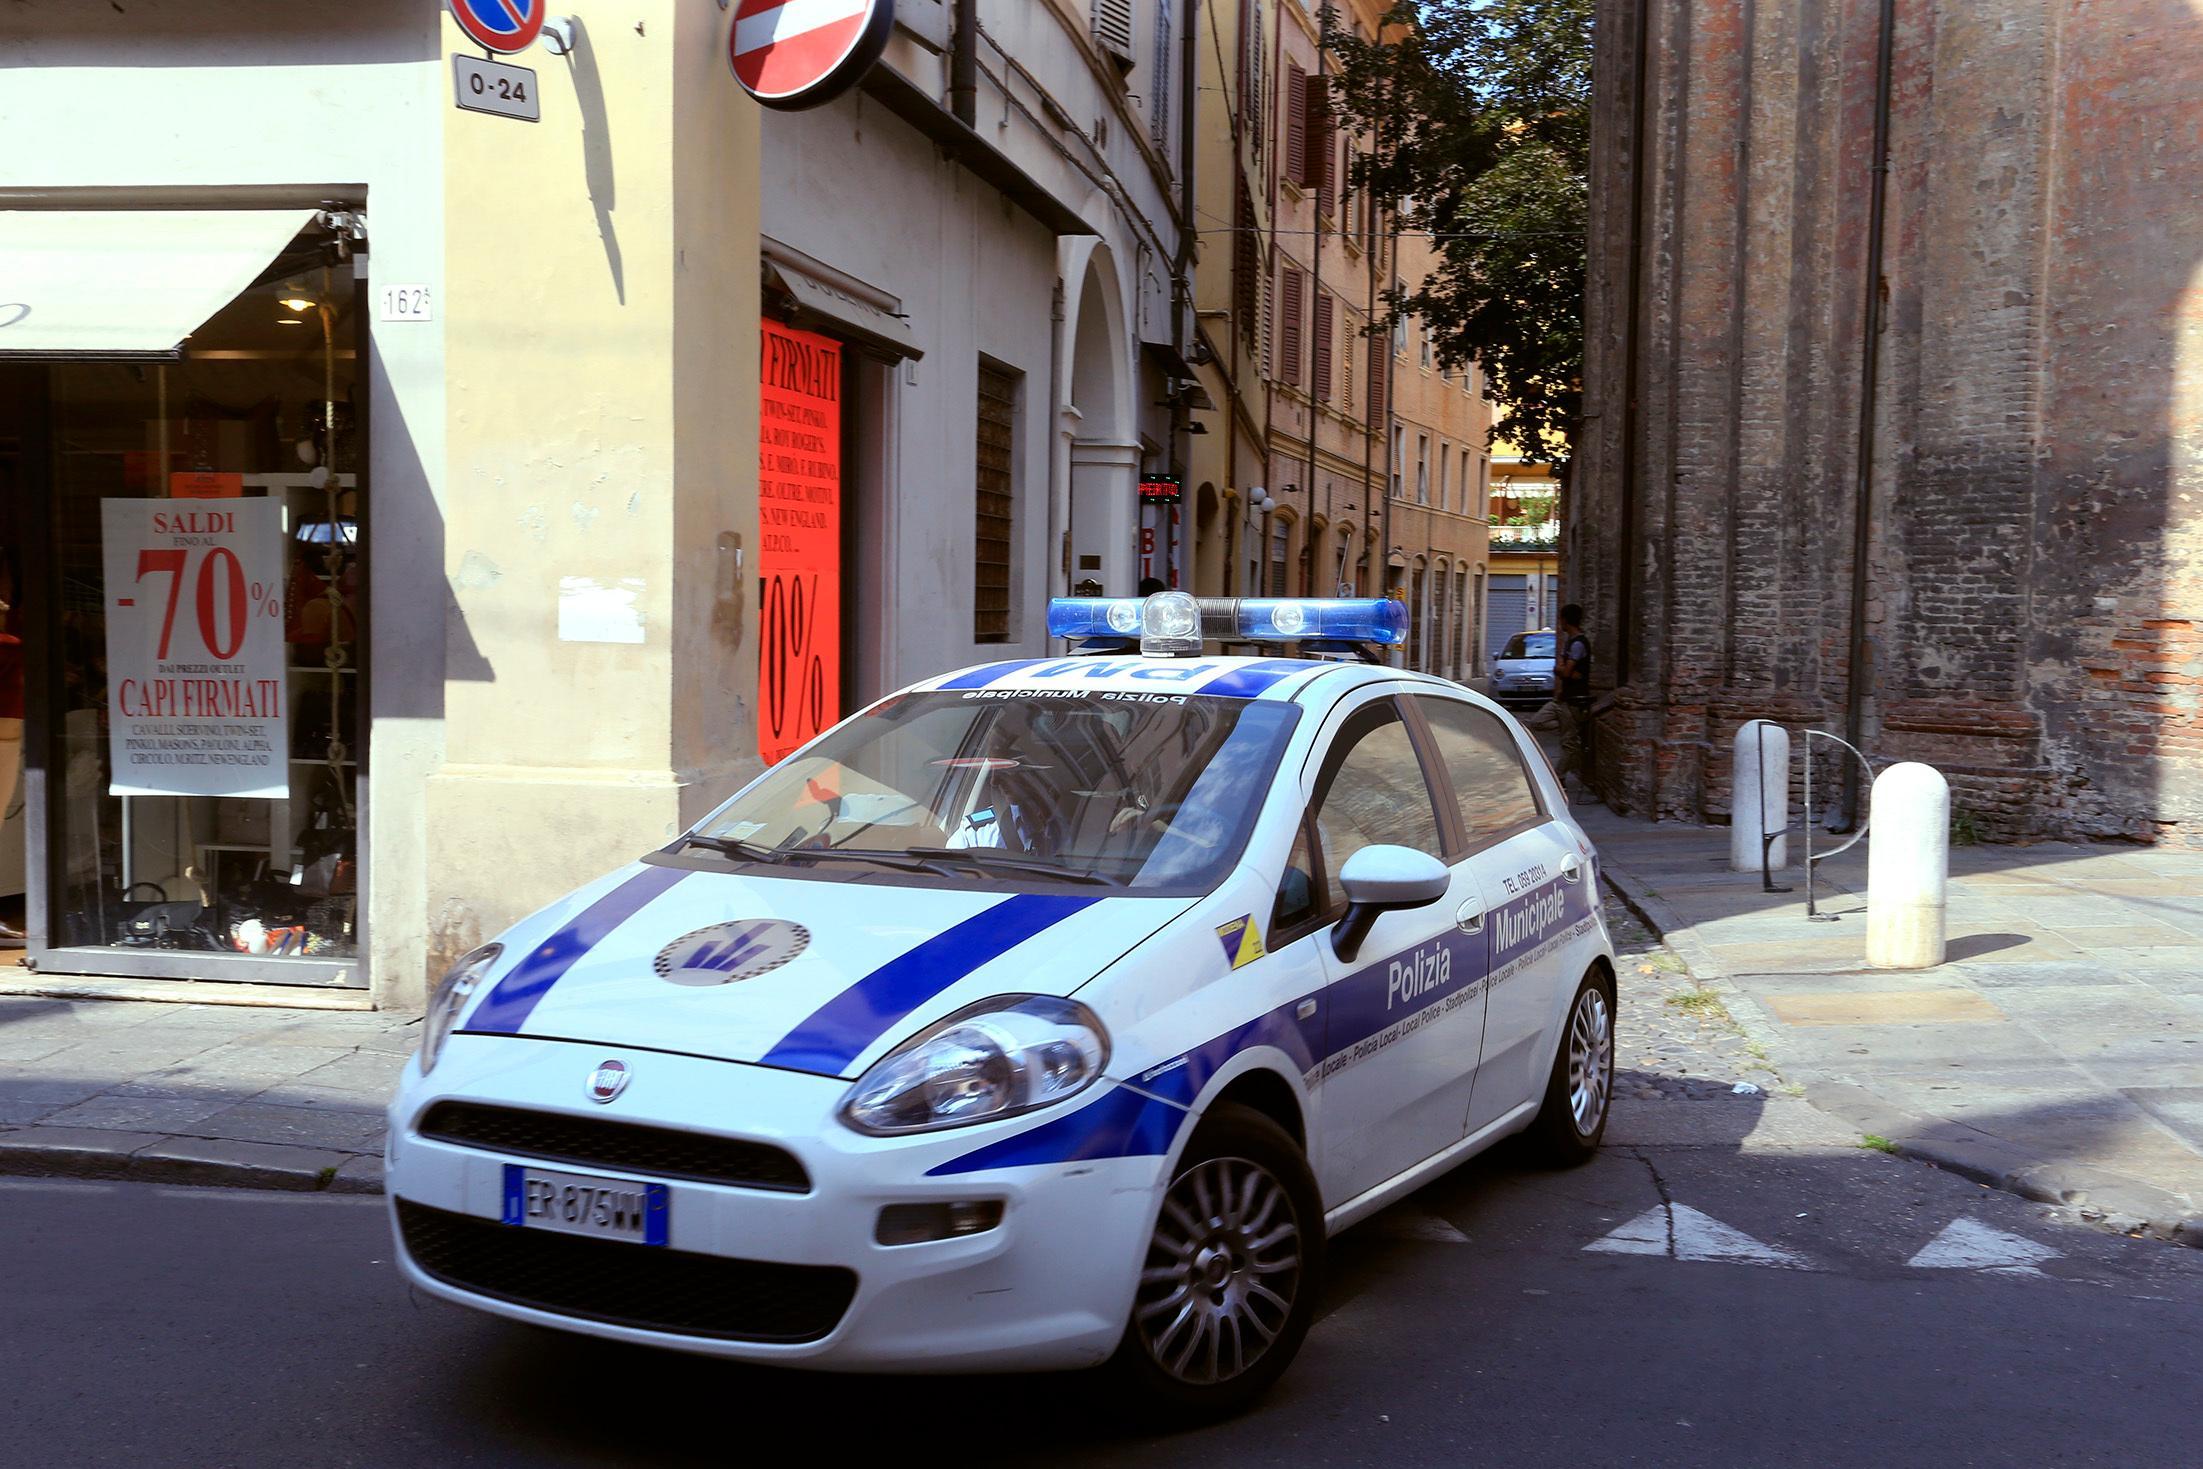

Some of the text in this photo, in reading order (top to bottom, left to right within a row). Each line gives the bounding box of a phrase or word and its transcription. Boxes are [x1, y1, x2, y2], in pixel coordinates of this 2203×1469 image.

[768, 332, 837, 402] FIRMATI
[153, 511, 236, 534] SALDI
[173, 536, 217, 546] FINO AL
[158, 664, 246, 674] DAI PREZZI OUTLET
[759, 574, 823, 739] 0%
[119, 678, 281, 718] CAPI FIRMATI
[1502, 878, 1519, 896] TEL.
[1387, 882, 1565, 1010] Polizia Municipale
[1321, 1052, 1348, 1079] Locale
[1401, 1018, 1420, 1036] Local
[1421, 1006, 1441, 1026] Police
[524, 1177, 556, 1220] ER
